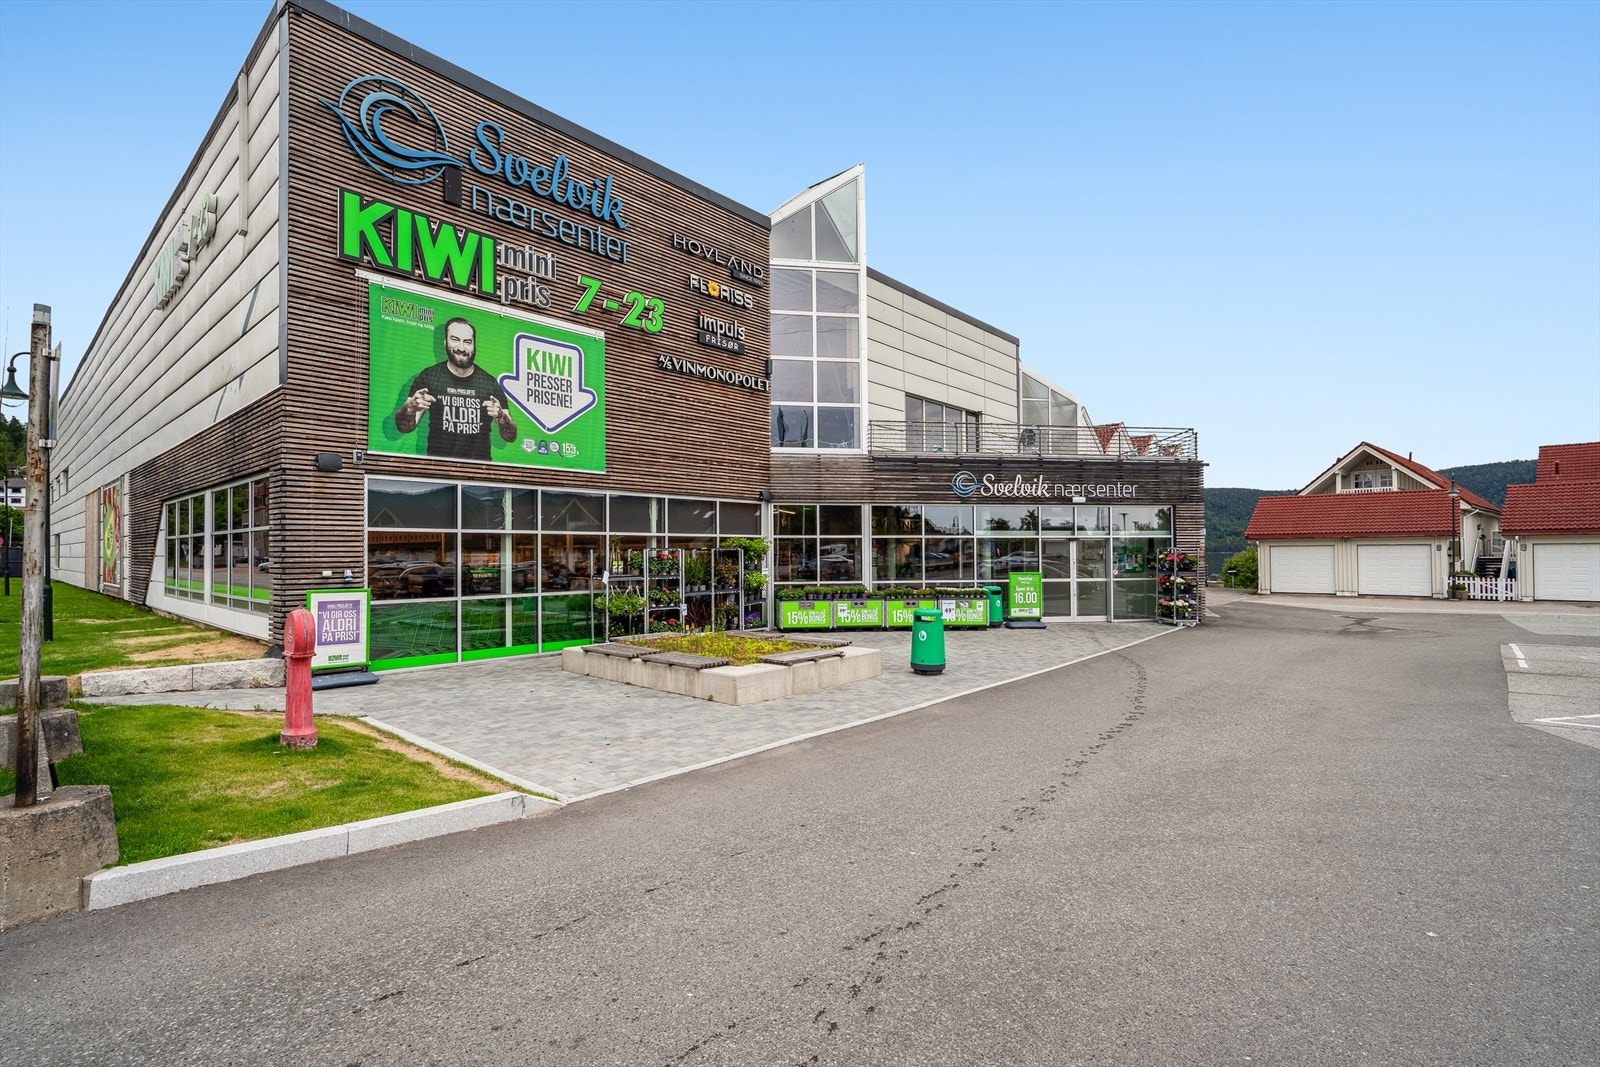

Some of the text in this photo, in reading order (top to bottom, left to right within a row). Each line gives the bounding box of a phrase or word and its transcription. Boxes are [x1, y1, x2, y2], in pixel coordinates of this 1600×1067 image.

[469, 120, 629, 229] Svelvik
[471, 185, 632, 263] nærsenter
[338, 187, 498, 297] KIWI
[501, 243, 557, 280] mini
[672, 233, 764, 278] HOVLAND
[501, 273, 551, 309] pris
[381, 296, 419, 320] KIWI
[419, 315, 433, 323] pris
[699, 310, 746, 341] impuls
[705, 334, 739, 351] FRISØR
[526, 347, 573, 378] KIWI
[673, 356, 770, 392] VINMONOPOLET
[526, 371, 573, 394] PRESSER
[451, 396, 465, 407] GIR
[465, 397, 481, 409] OSS
[526, 387, 573, 409] PRISENE!
[442, 405, 481, 423] ALDRI
[442, 420, 455, 433] PÅ
[980, 473, 1138, 498] Svelvik nærsenter
[1013, 591, 1037, 604] 16.00
[322, 617, 357, 632] ALDRI
[331, 610, 343, 619] GIR
[343, 609, 357, 618] OSS
[786, 611, 808, 625] 15%
[892, 609, 914, 623] 15%
